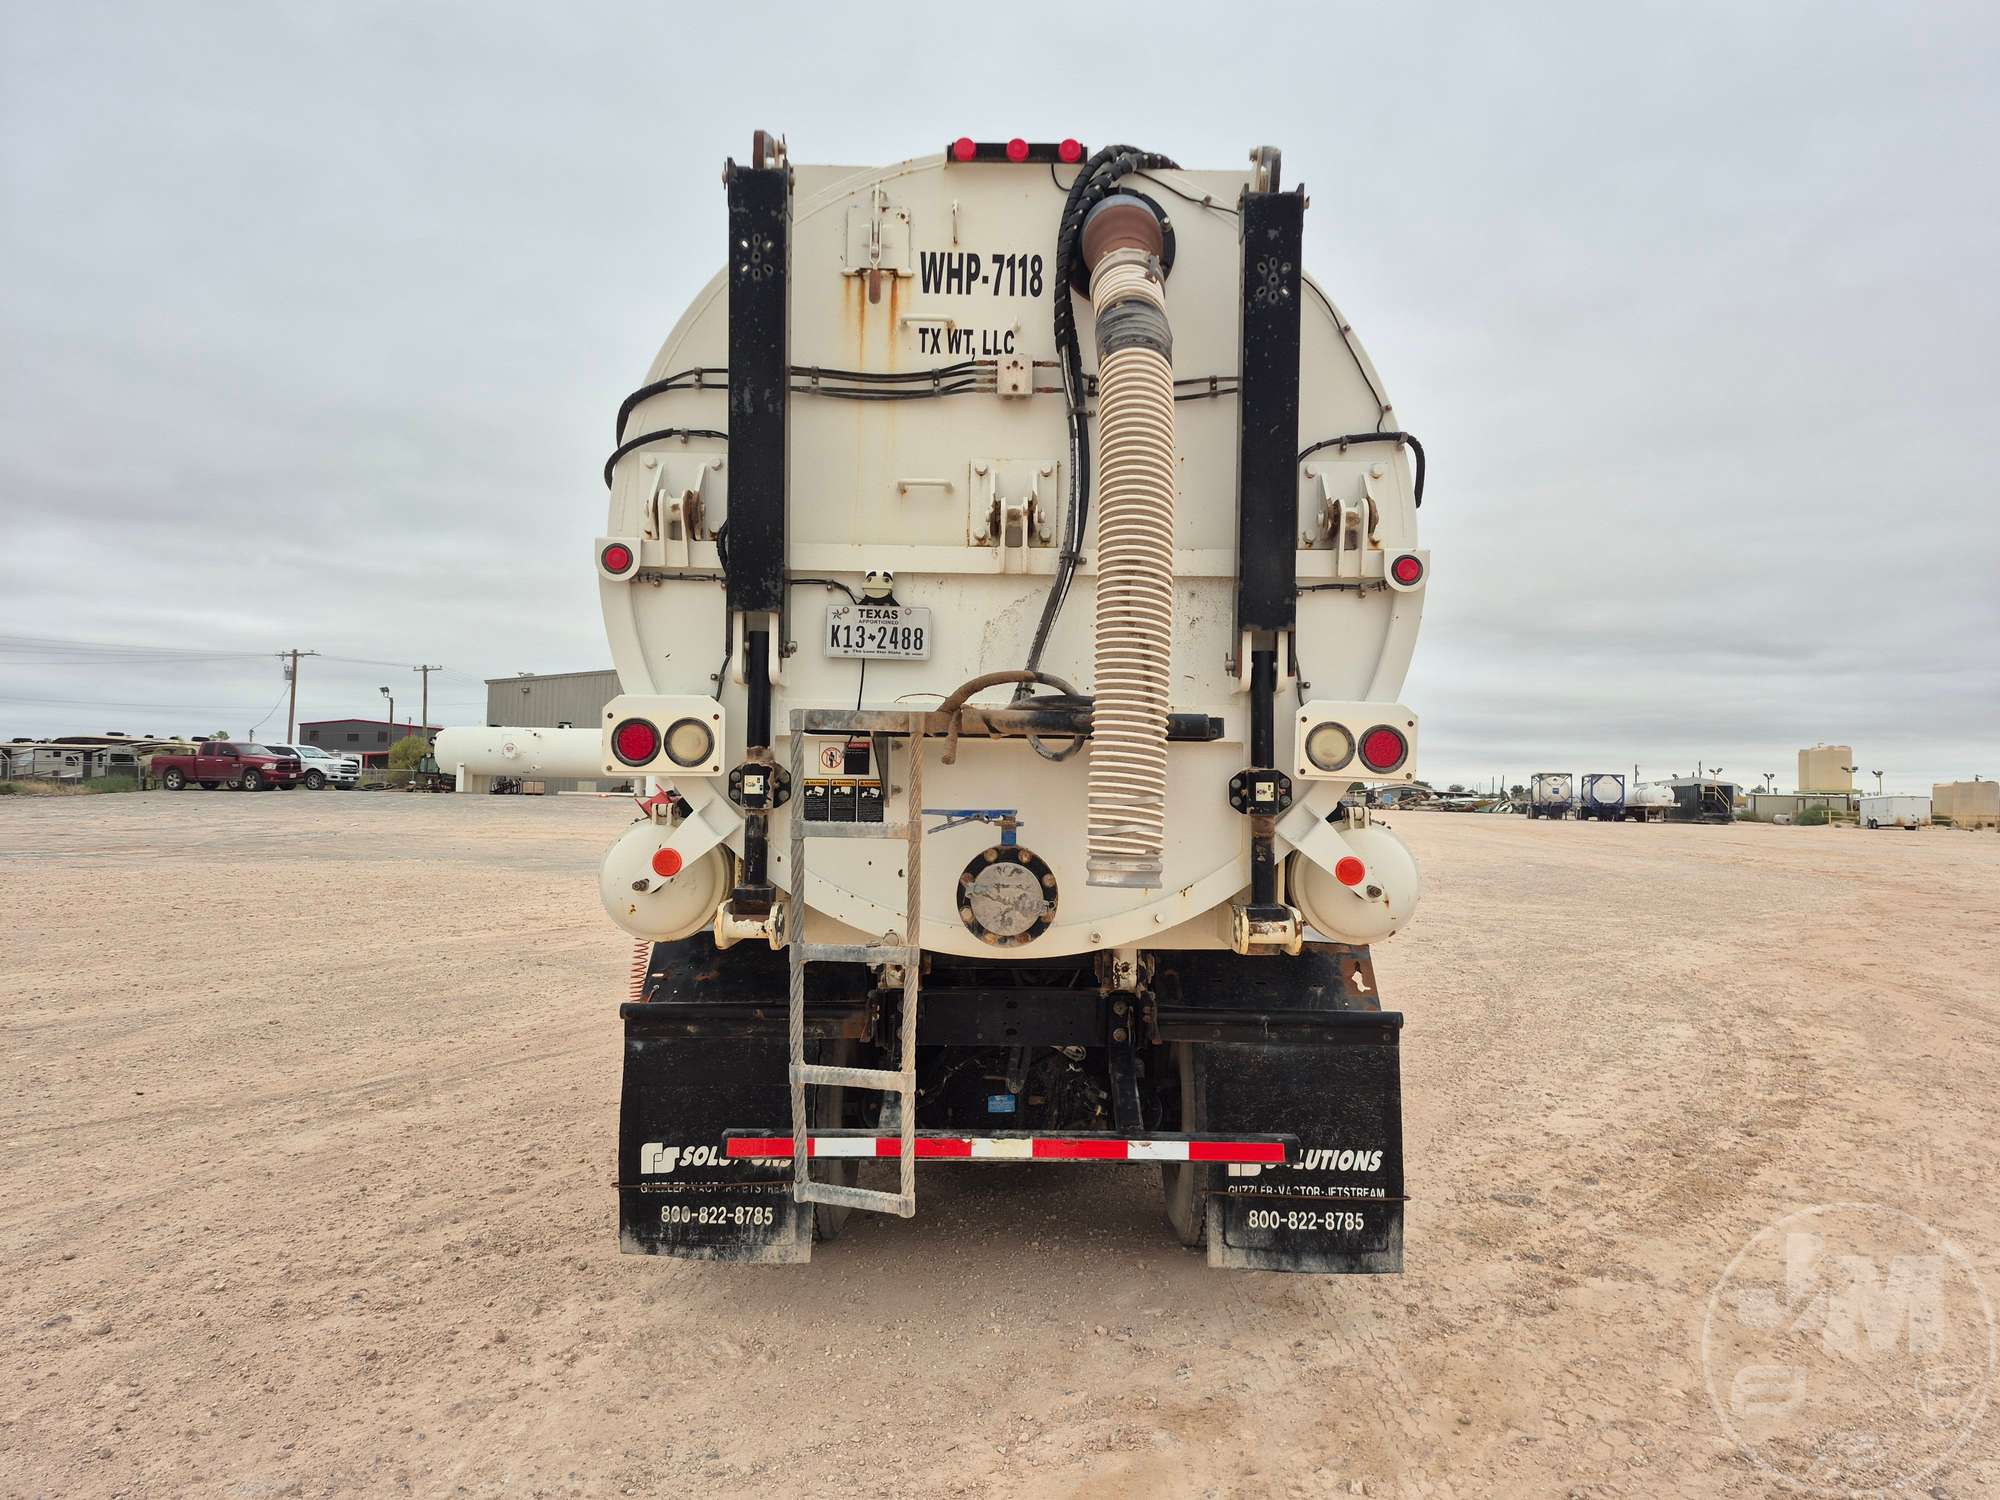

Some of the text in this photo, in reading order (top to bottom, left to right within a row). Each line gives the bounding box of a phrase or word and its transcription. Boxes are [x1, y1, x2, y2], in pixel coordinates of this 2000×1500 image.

[920, 251, 1043, 298] WHP-7118
[918, 327, 1015, 361] TX WT, LLC
[858, 608, 899, 619] TEXAS
[1265, 1149, 1384, 1172] LUTIONS
[660, 1204, 774, 1226] 800-822-8785
[1248, 1209, 1365, 1231] 800-822-8785
